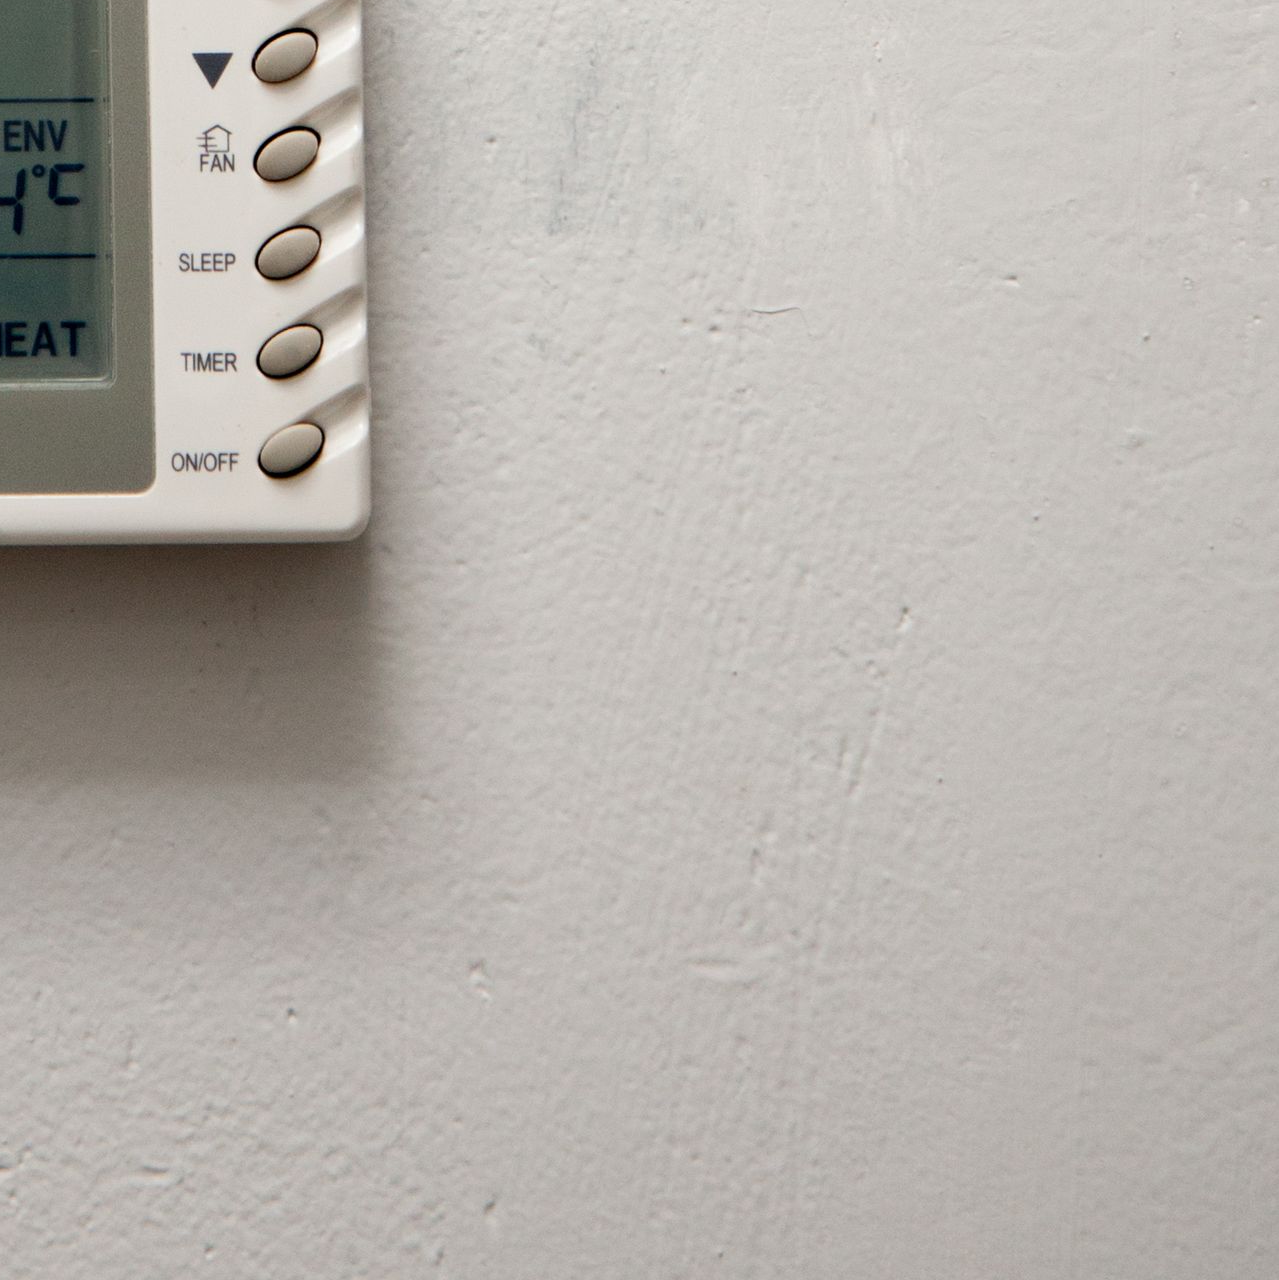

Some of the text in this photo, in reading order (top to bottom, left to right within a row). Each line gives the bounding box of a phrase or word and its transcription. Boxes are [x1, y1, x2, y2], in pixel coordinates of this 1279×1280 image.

[4, 121, 68, 152] ENV
[198, 154, 235, 173] FAN
[178, 252, 236, 274] SLEEP
[180, 352, 237, 373] TIMER
[170, 451, 239, 473] ON/OFF
